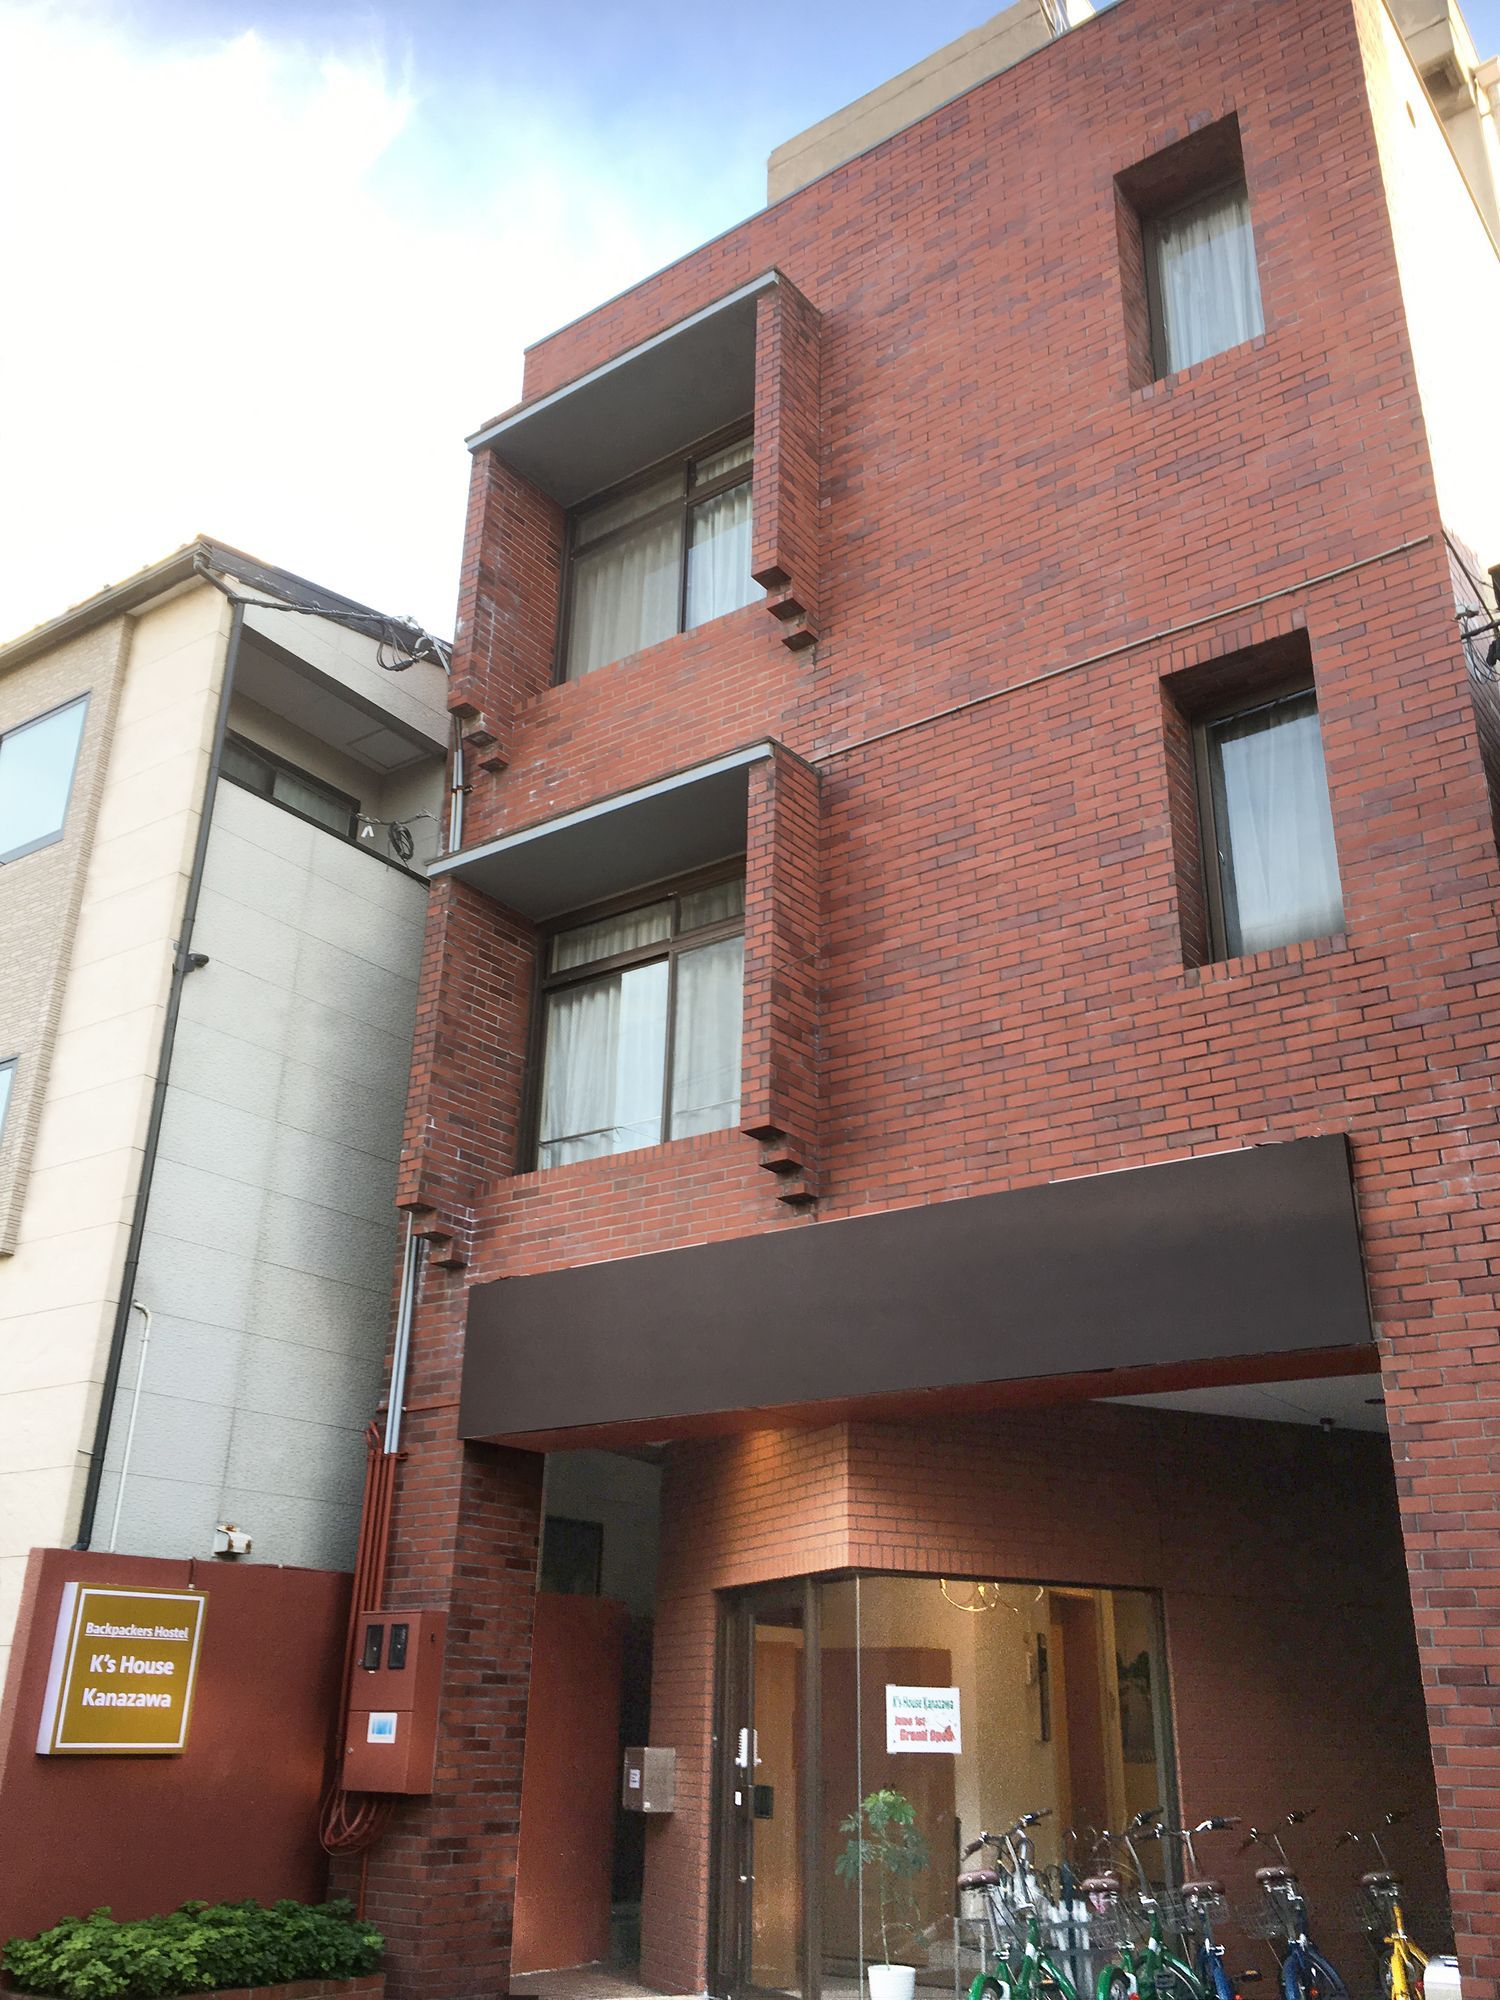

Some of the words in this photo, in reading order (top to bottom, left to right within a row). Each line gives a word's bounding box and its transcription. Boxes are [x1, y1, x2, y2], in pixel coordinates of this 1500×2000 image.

[85, 1622, 153, 1637] Backpackers
[154, 1626, 189, 1639] Hostel
[90, 1654, 117, 1673] K's
[120, 1656, 175, 1675] House
[82, 1688, 171, 1708] Kanazawa
[903, 1697, 922, 1709] House
